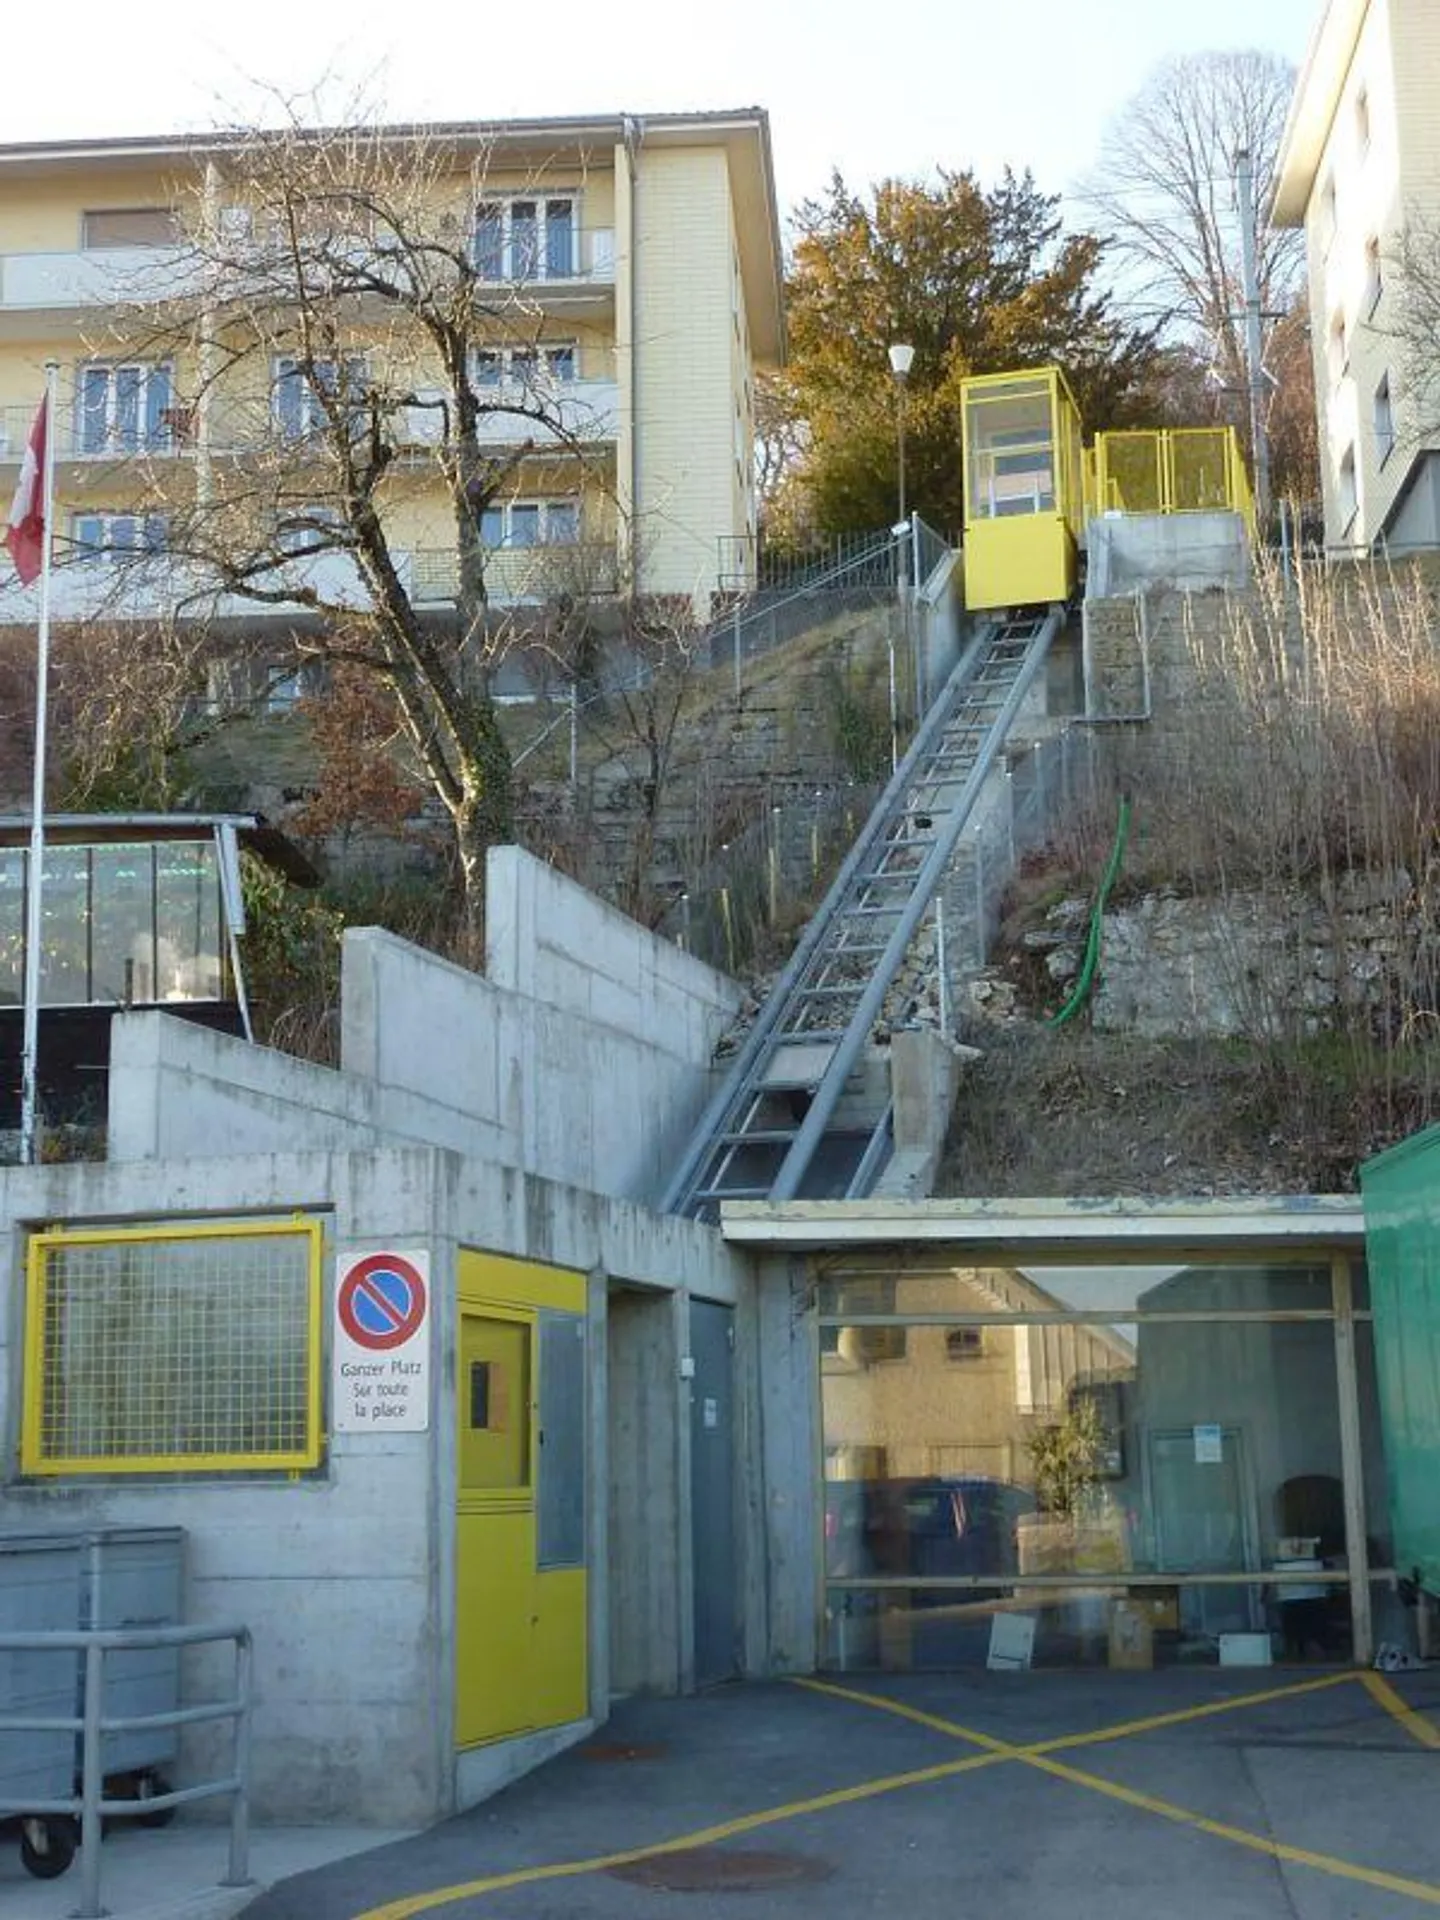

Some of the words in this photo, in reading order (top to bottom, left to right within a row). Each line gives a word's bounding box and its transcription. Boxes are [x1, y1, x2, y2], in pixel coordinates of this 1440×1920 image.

[341, 1363, 384, 1377] Ganzer
[391, 1360, 421, 1374] Platz
[353, 1382, 372, 1398] Sur
[377, 1383, 408, 1396] toute
[355, 1402, 366, 1417] la
[372, 1402, 406, 1422] place
